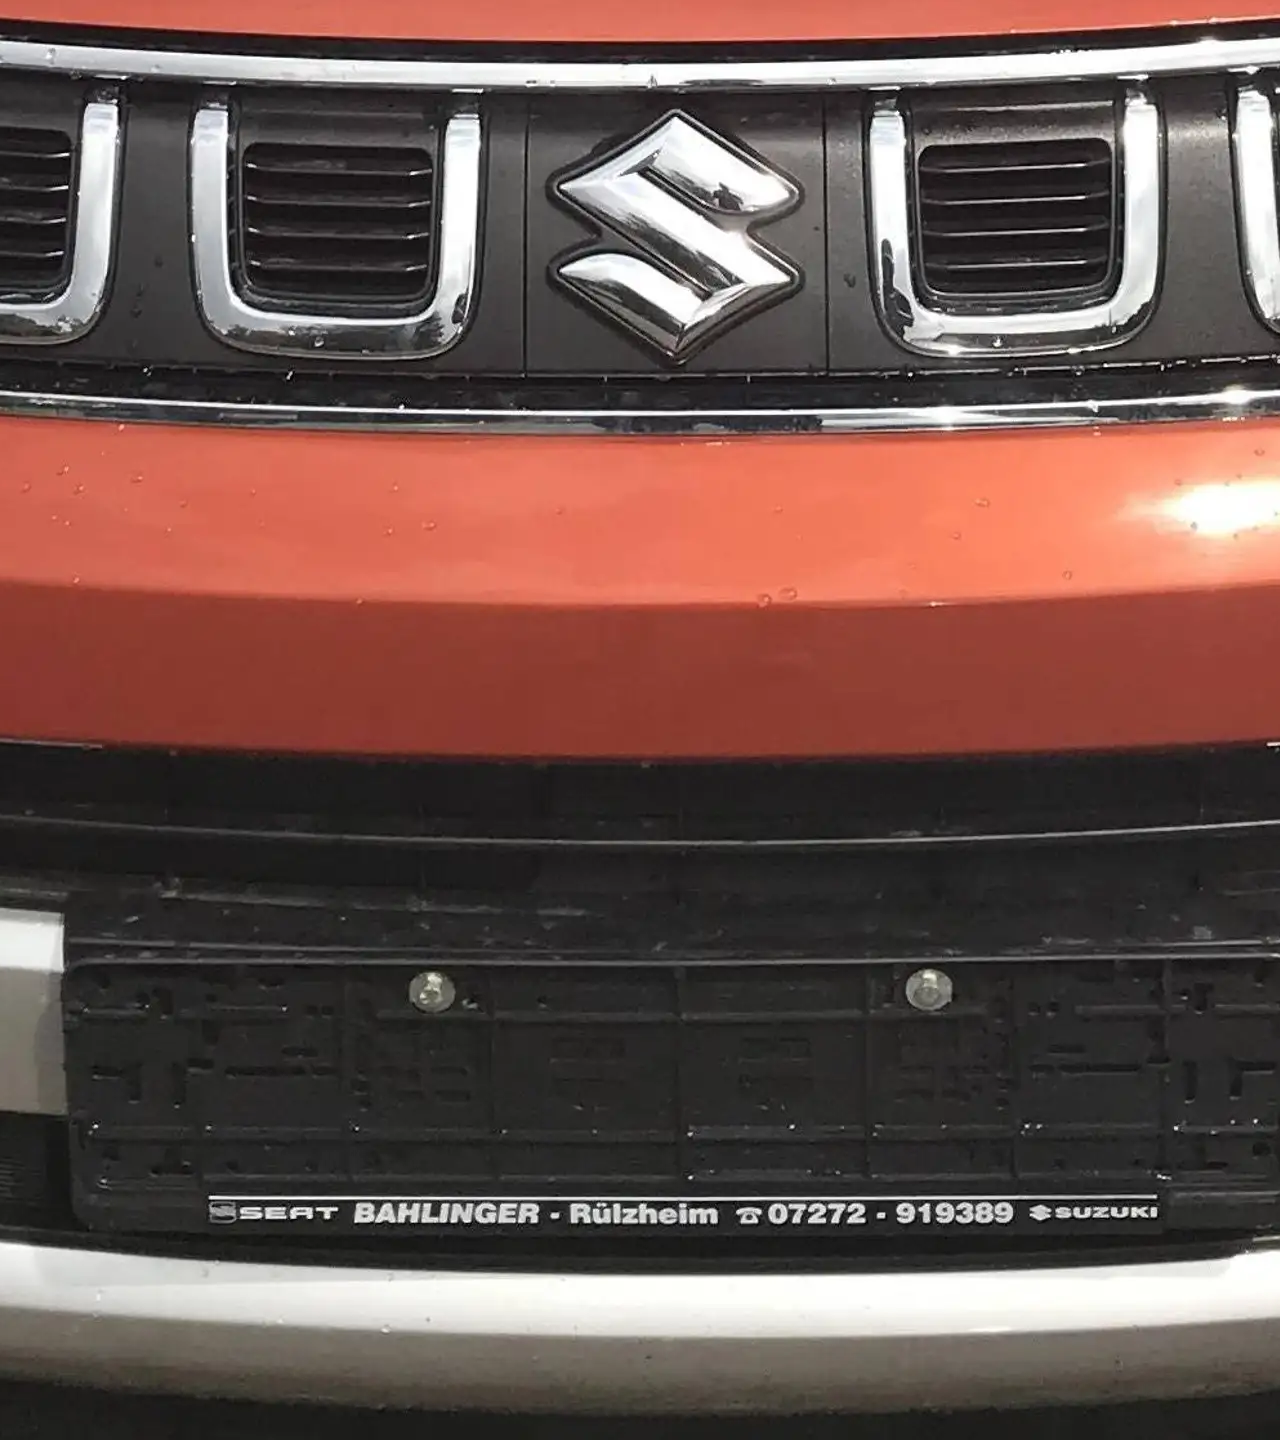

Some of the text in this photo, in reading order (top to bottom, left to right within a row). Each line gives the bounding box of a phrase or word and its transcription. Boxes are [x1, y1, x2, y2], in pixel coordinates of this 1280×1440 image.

[239, 1206, 339, 1221] SEAT
[354, 1202, 540, 1224] BAHLINGER
[570, 1202, 719, 1225] Rülzheim
[767, 1202, 867, 1225] 07272
[896, 1202, 1014, 1224] 919389
[1055, 1205, 1158, 1220] SUZUKI
